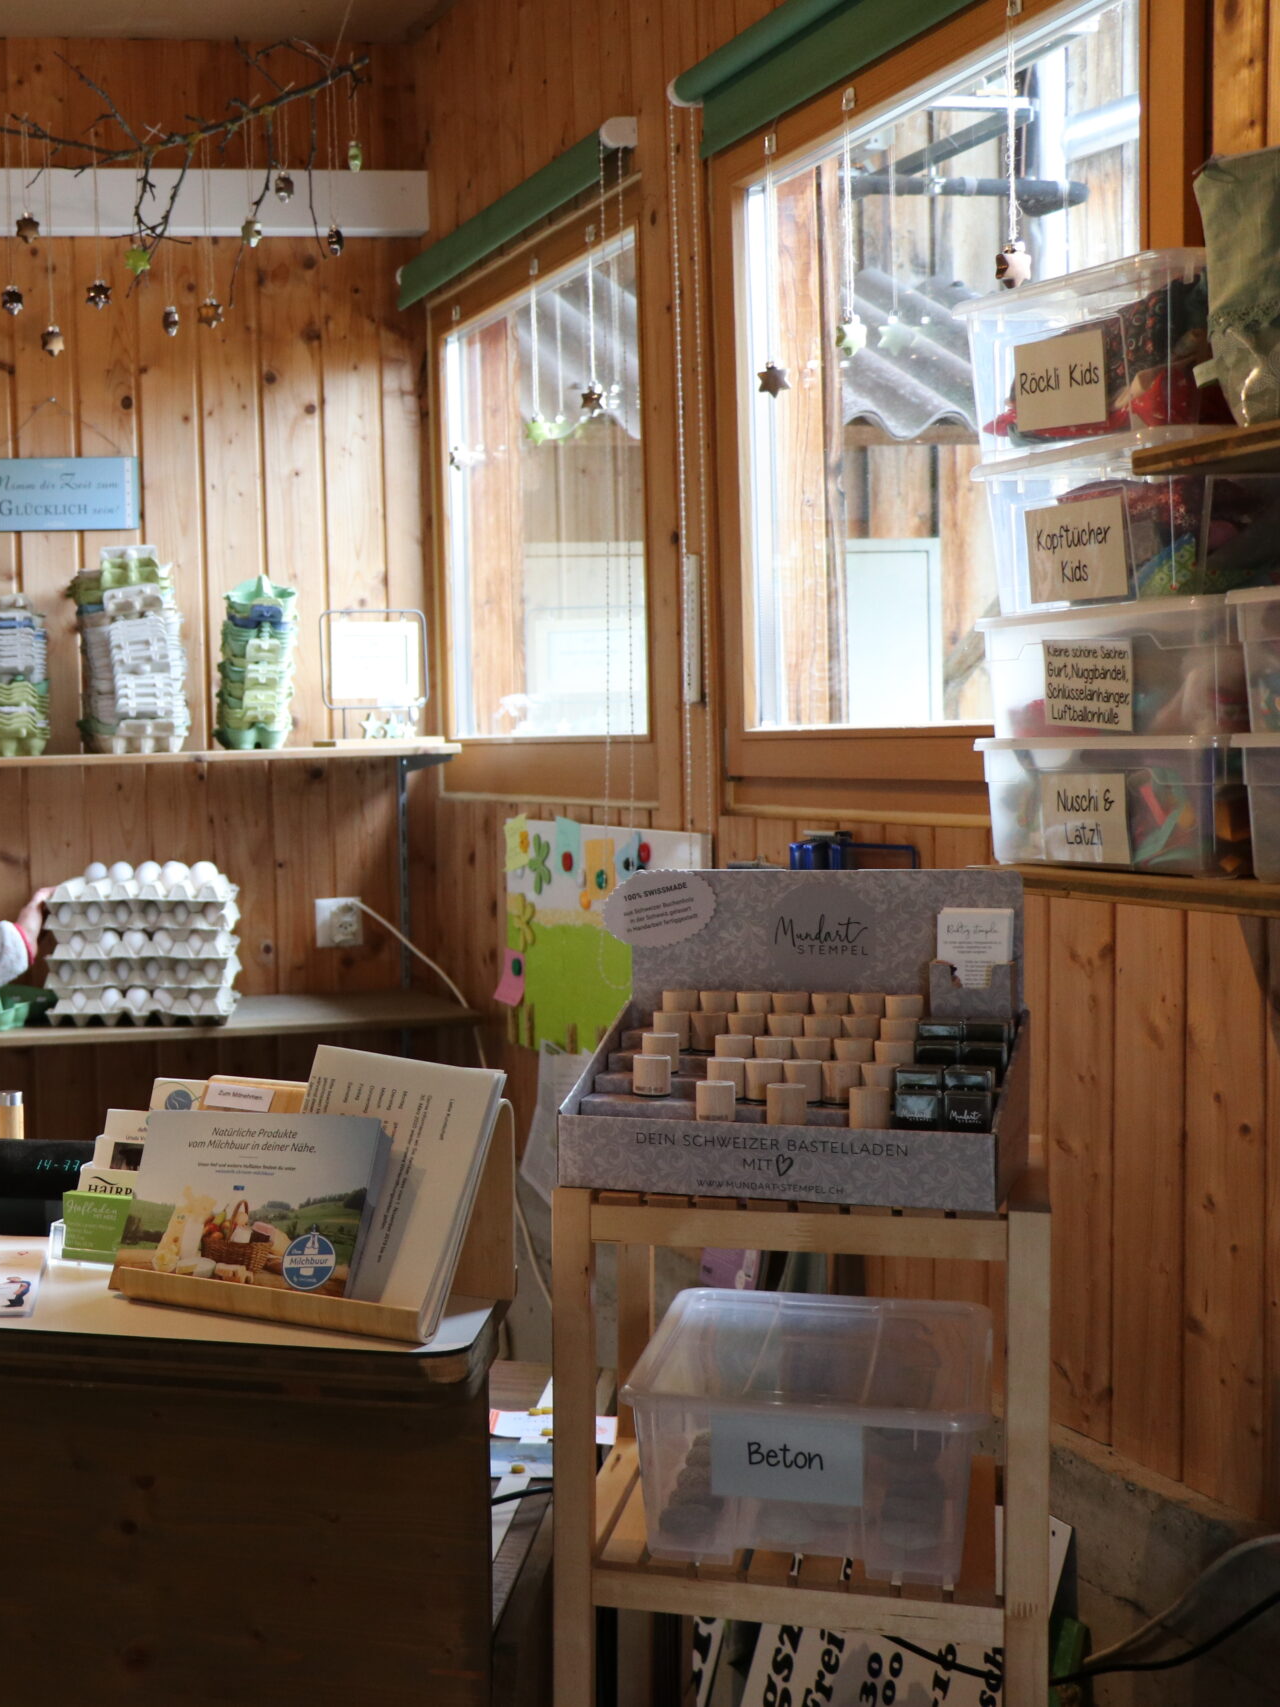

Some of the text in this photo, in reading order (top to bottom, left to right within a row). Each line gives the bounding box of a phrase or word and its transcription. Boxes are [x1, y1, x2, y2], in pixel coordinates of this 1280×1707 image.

[1020, 361, 1099, 395] Röckli Kids
[1036, 522, 1111, 555] Kopftücher
[1061, 561, 1089, 584] Kids
[1051, 703, 1119, 725] Luftballonhülle
[1056, 788, 1115, 813] Nuschi &
[1065, 823, 1103, 846] Lätzli
[624, 882, 688, 902] 100% SWISSMADE
[775, 914, 868, 947] Mundart
[797, 944, 868, 956] STEMPEL
[212, 1127, 298, 1140] Natürliche Produkte
[635, 1132, 909, 1157] DEIN SCHWEIZER BASTELLADEN
[188, 1138, 317, 1154] vom Milchbuur in deiner Nähe.
[742, 1157, 773, 1171] MIT
[289, 1257, 328, 1266] Milchbuur
[746, 1441, 824, 1472] Beton
